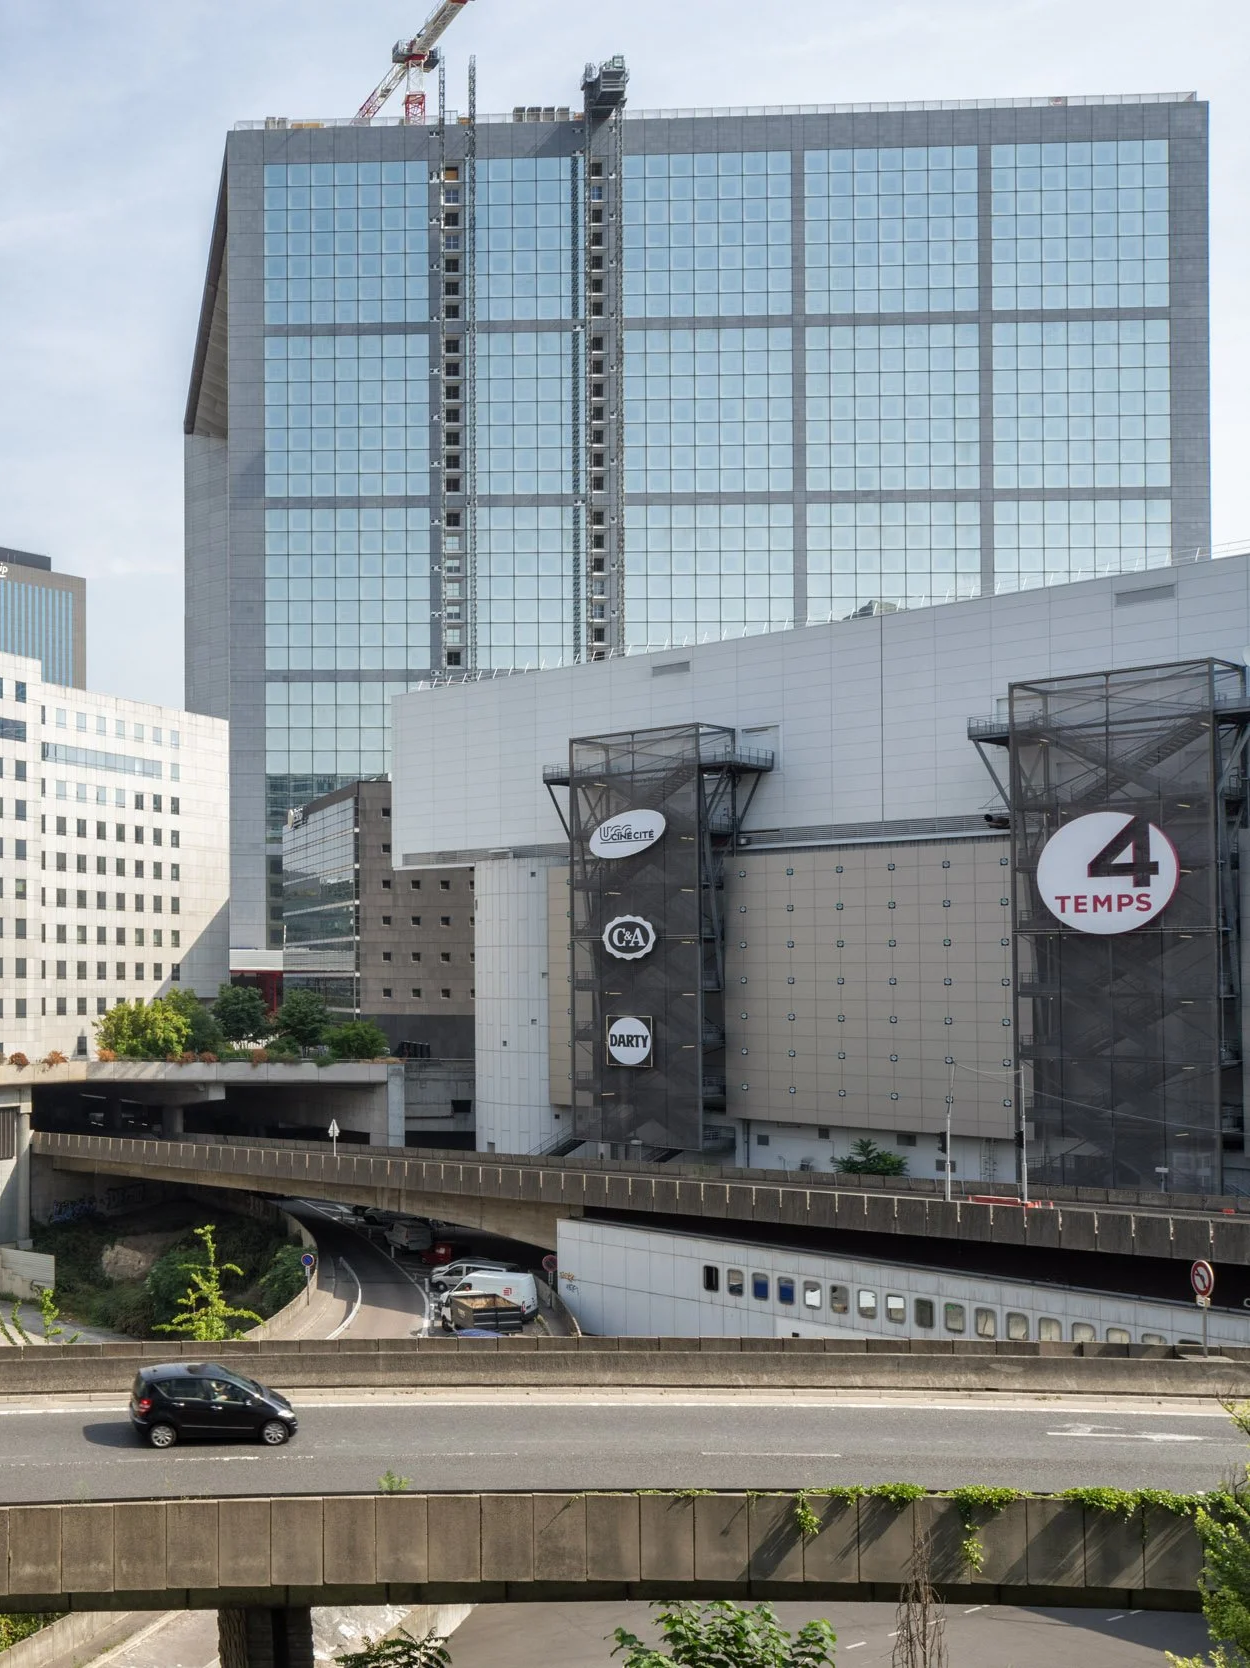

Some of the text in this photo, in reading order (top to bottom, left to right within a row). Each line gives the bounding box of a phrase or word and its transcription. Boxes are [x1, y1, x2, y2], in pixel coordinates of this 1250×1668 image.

[1087, 816, 1159, 888] 4
[1055, 893, 1152, 914] TEMPS
[612, 927, 646, 947] C&A
[609, 1033, 649, 1049] DARTY
